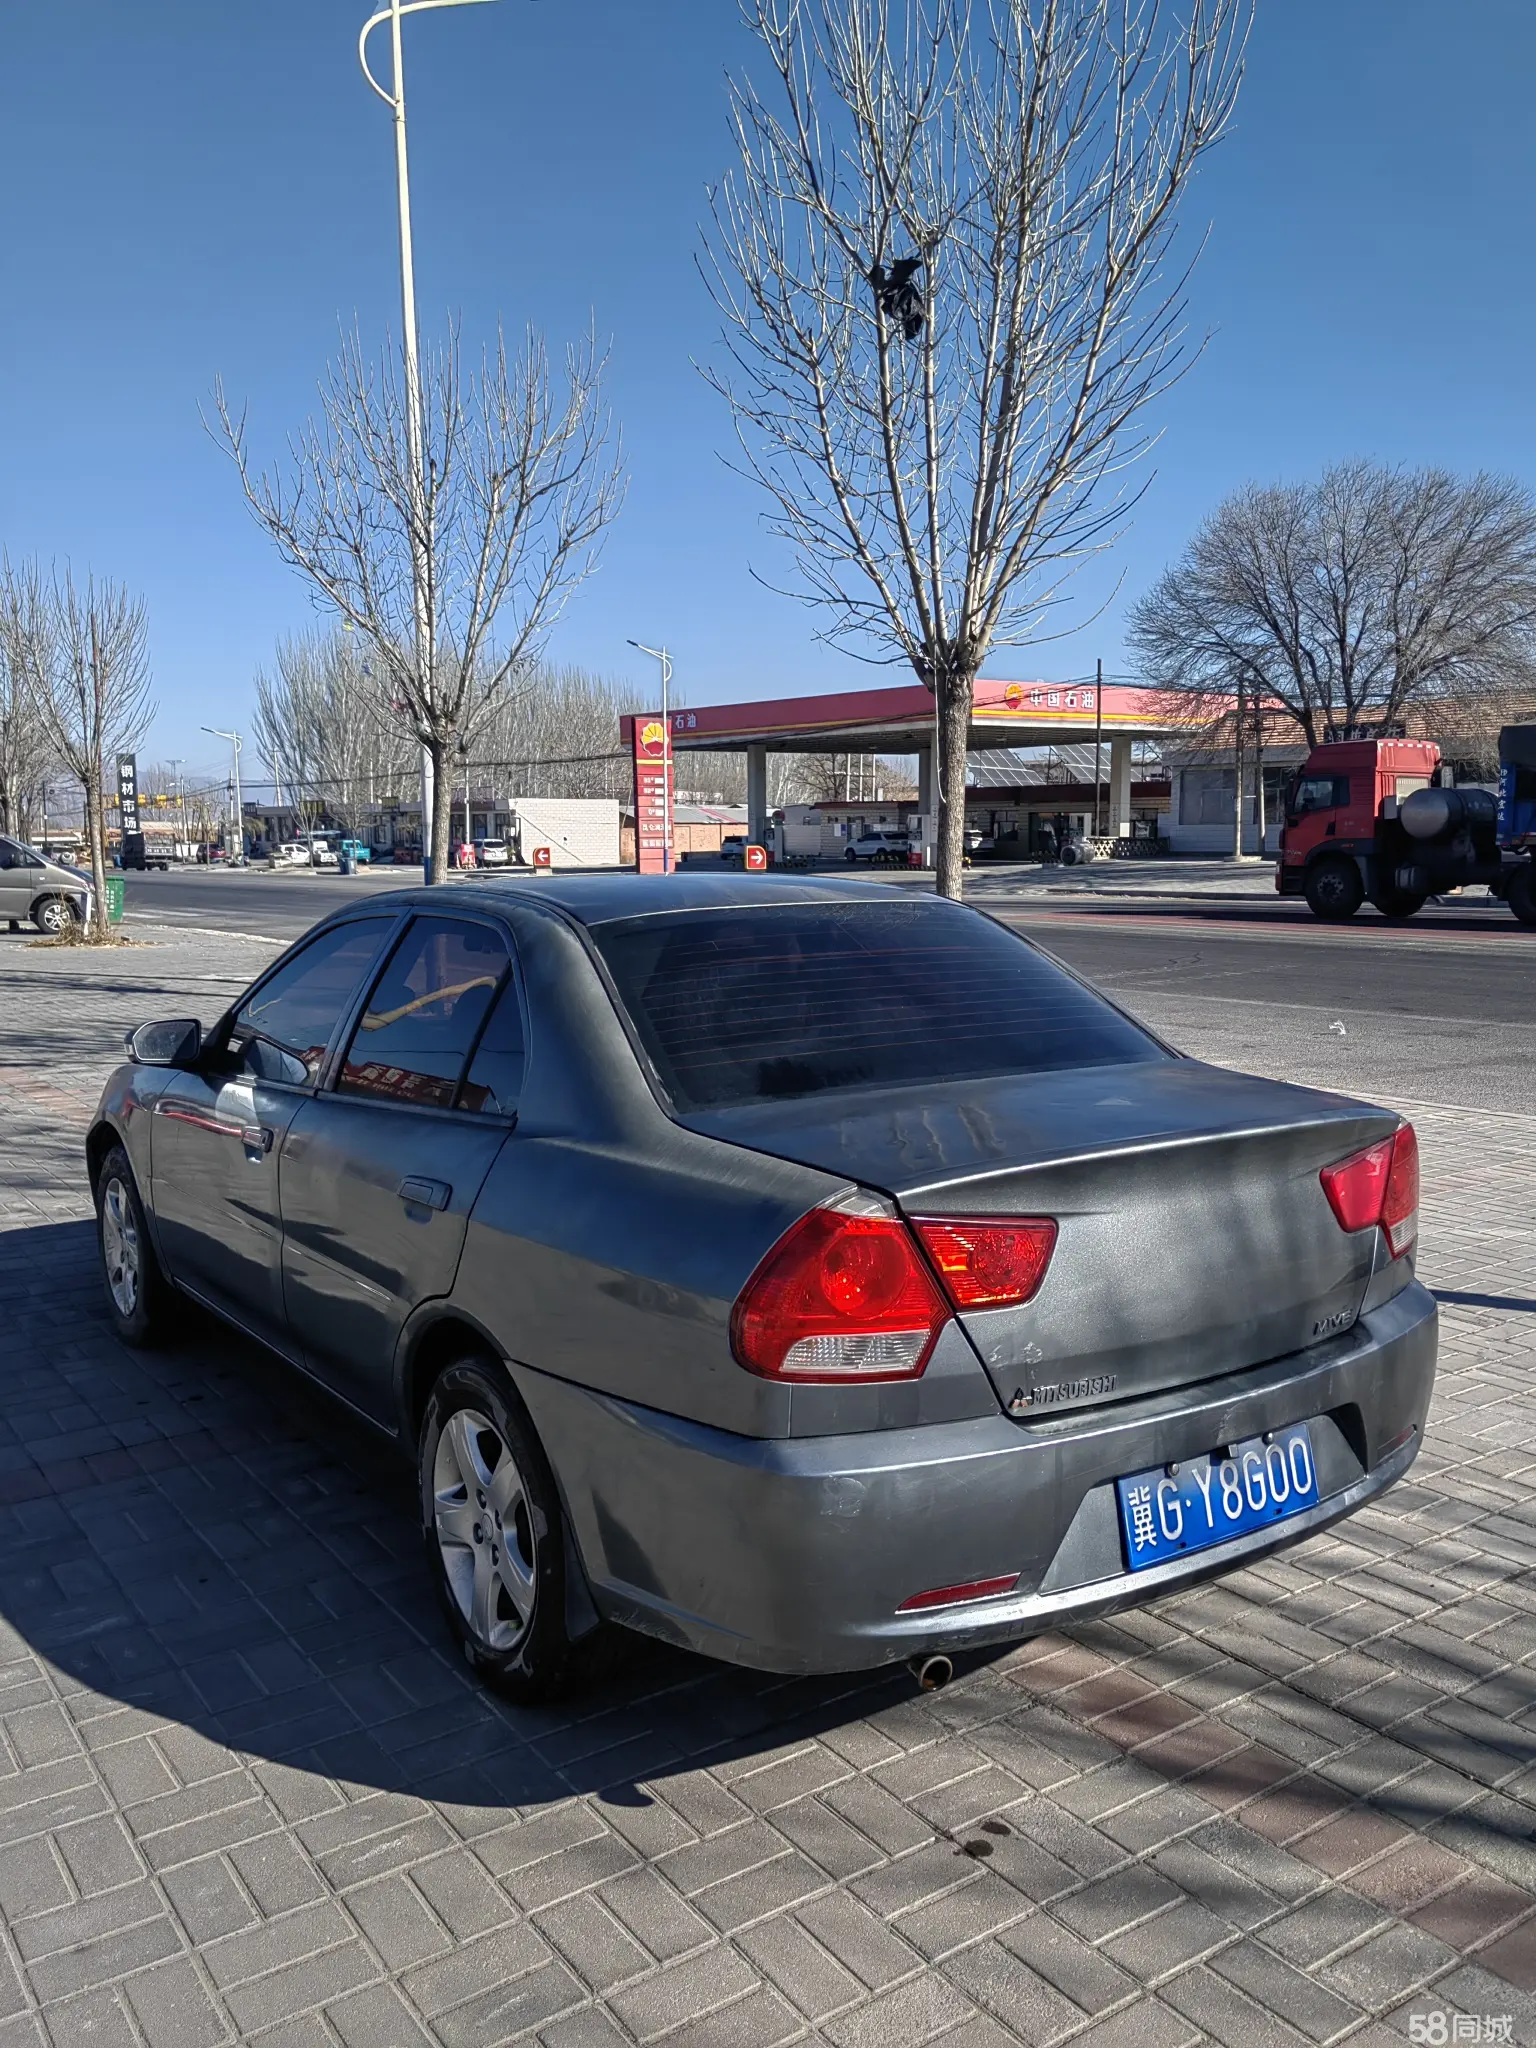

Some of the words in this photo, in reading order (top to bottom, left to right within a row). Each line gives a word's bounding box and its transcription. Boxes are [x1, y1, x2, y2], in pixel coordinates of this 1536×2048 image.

[1030, 688, 1095, 709] 中国石油
[120, 764, 137, 830] 钢材市场
[1032, 1374, 1118, 1406] MITSUBISHI
